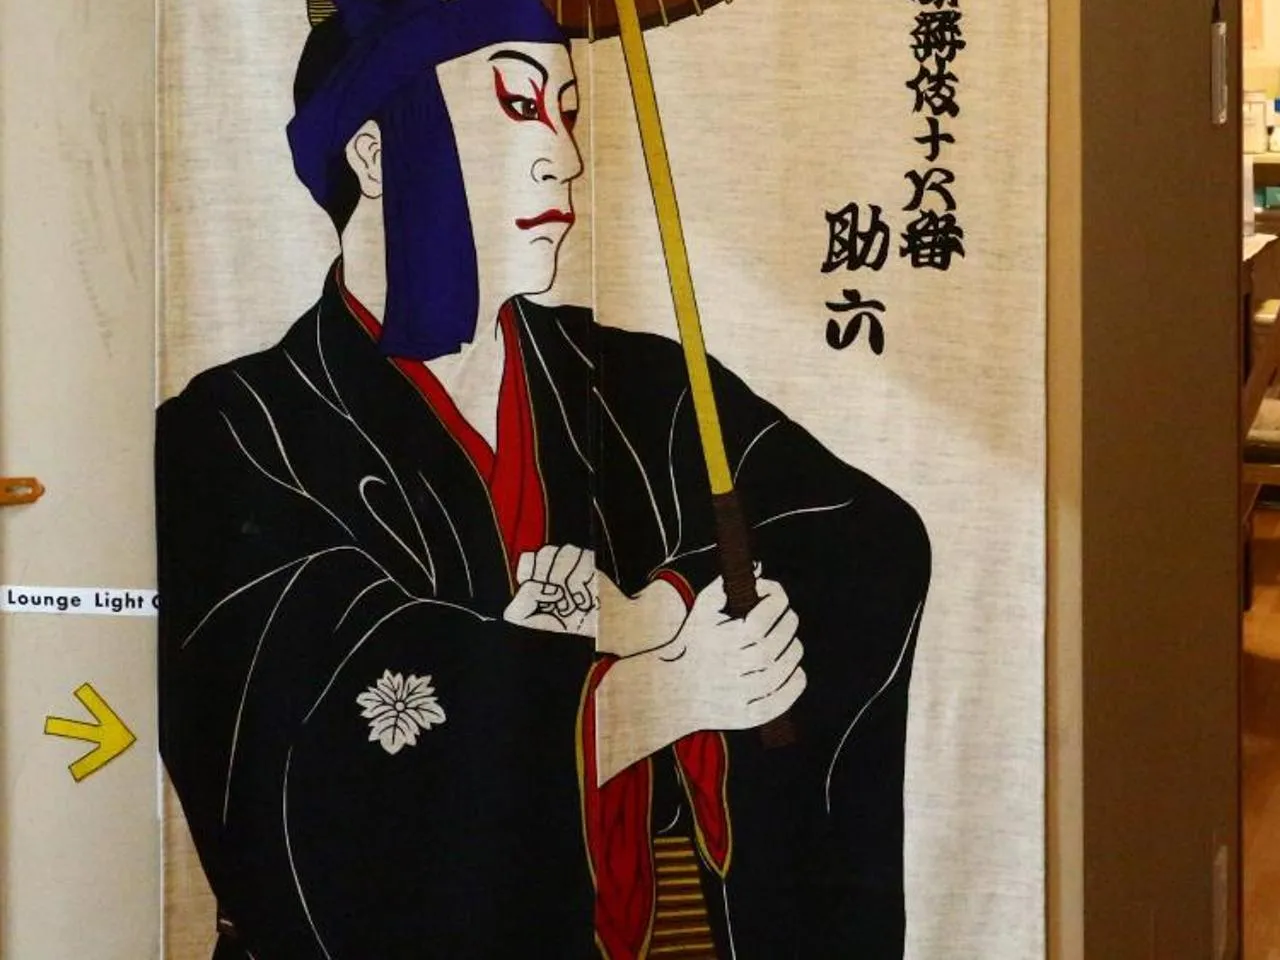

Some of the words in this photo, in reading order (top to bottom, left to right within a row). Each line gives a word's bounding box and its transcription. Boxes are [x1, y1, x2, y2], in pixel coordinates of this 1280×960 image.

[820, 201, 891, 356] 助六
[8, 590, 82, 611] Lounge
[95, 592, 144, 612] Light
